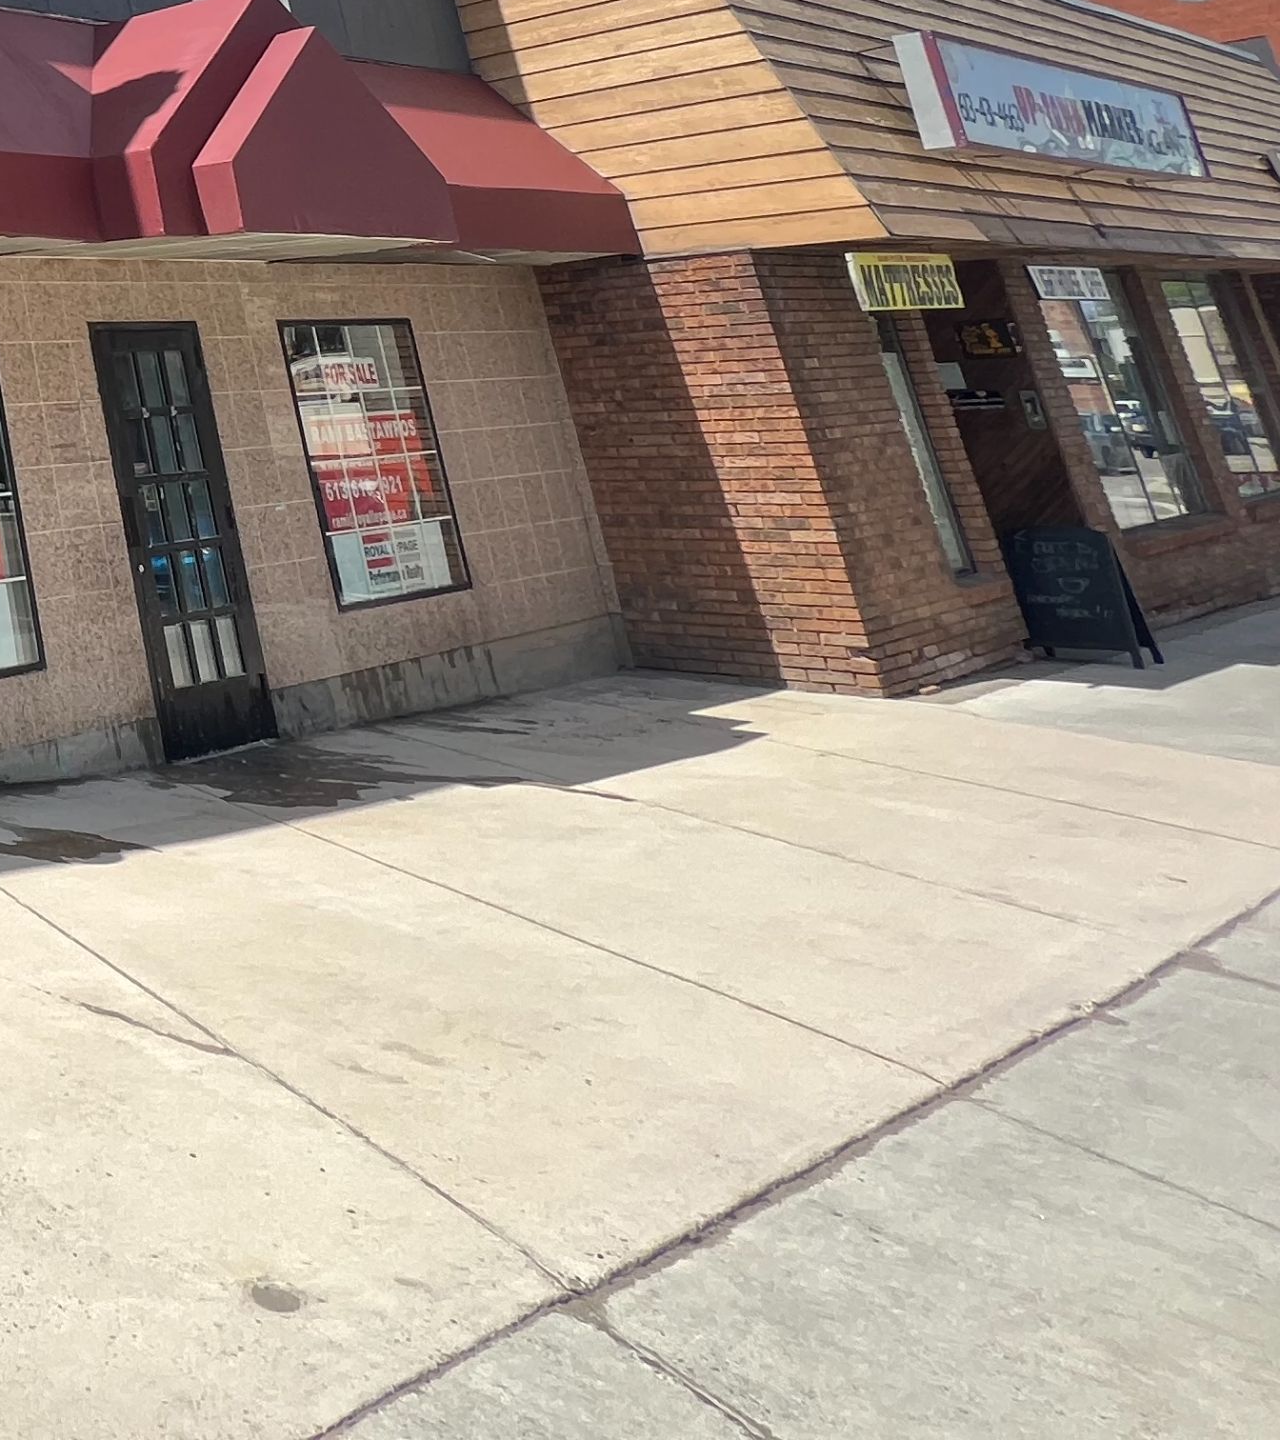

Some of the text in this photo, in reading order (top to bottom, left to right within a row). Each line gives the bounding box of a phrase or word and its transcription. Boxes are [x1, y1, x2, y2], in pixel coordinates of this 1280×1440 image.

[860, 264, 960, 307] MATTRESSES
[324, 363, 377, 385] FOR SALE
